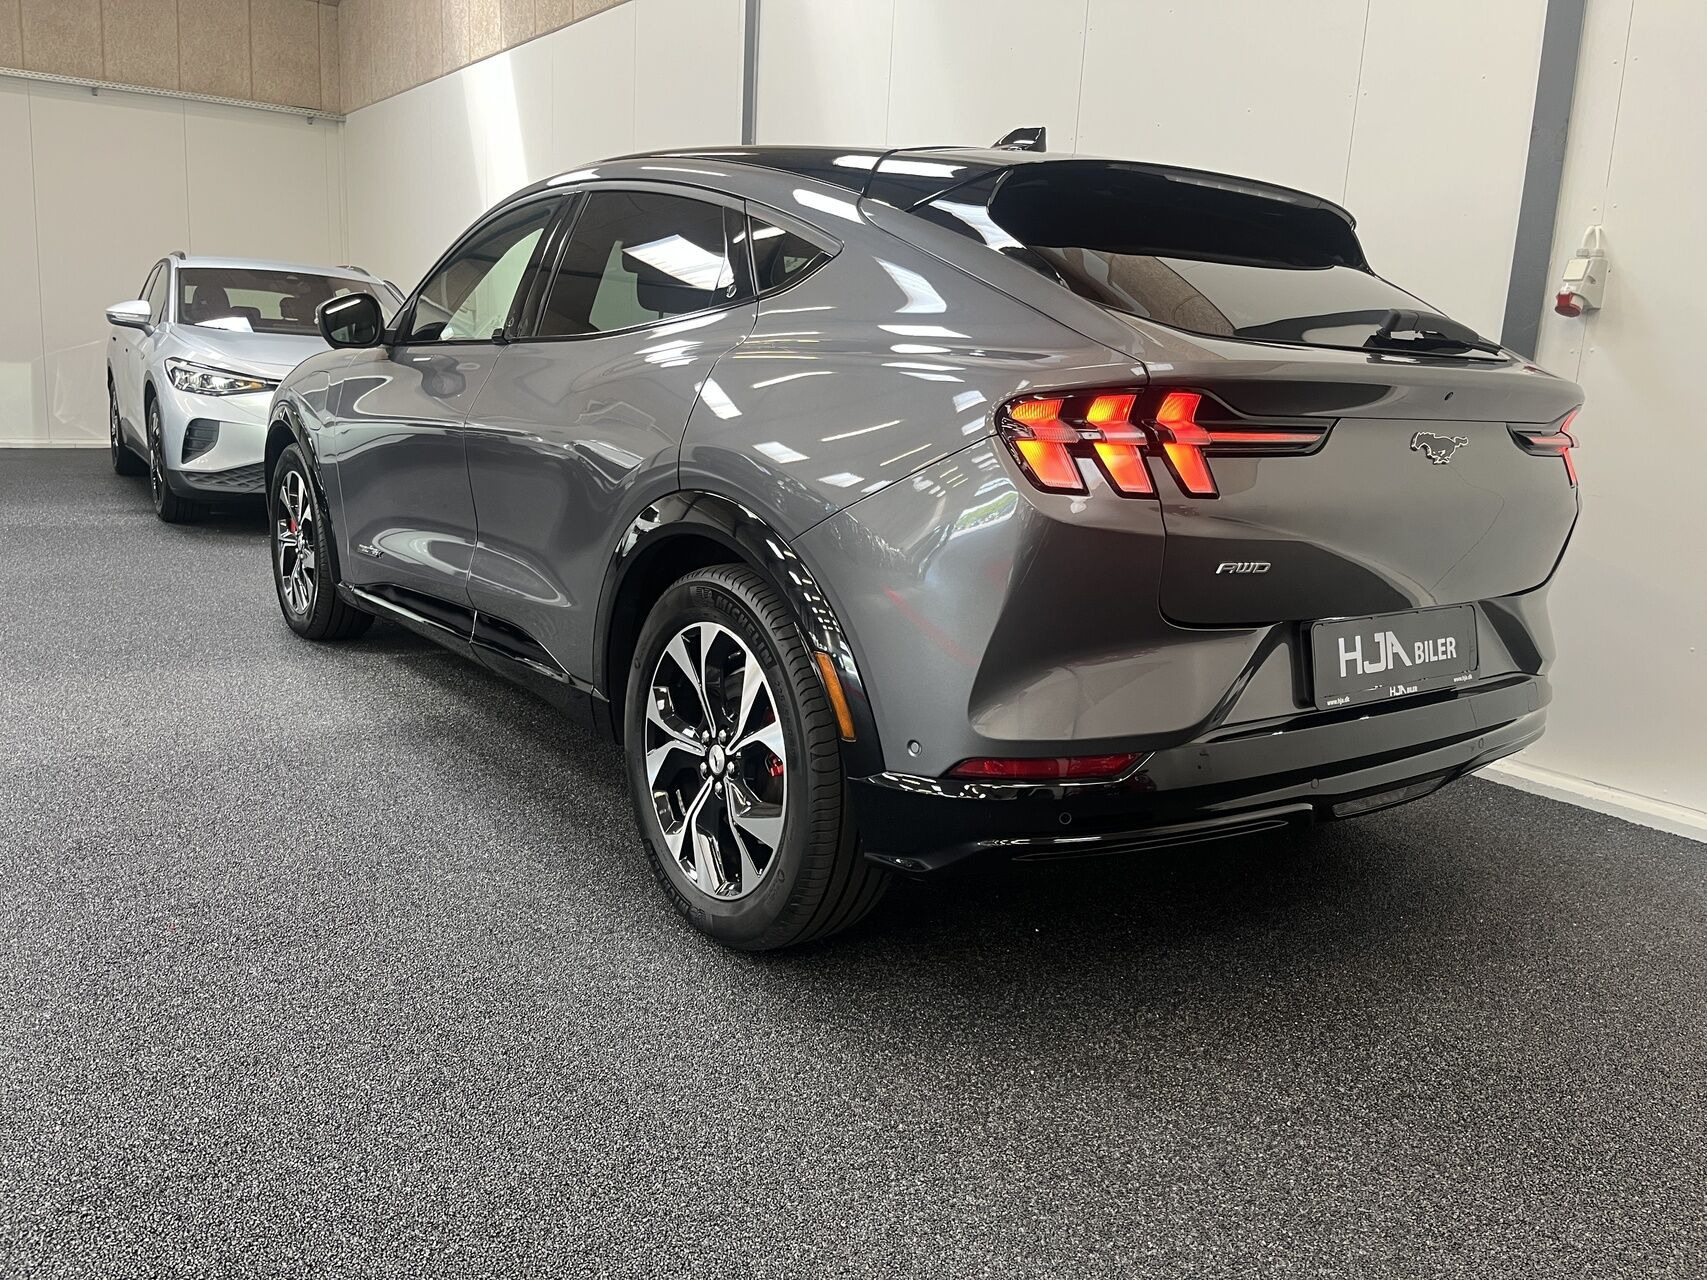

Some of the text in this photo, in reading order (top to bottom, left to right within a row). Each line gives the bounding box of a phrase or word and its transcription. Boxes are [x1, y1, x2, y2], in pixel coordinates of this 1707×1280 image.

[1215, 562, 1271, 574] AWD
[715, 595, 774, 665] MICHELIN
[1337, 630, 1457, 678] HJA BILER
[1389, 684, 1407, 697] HJA
